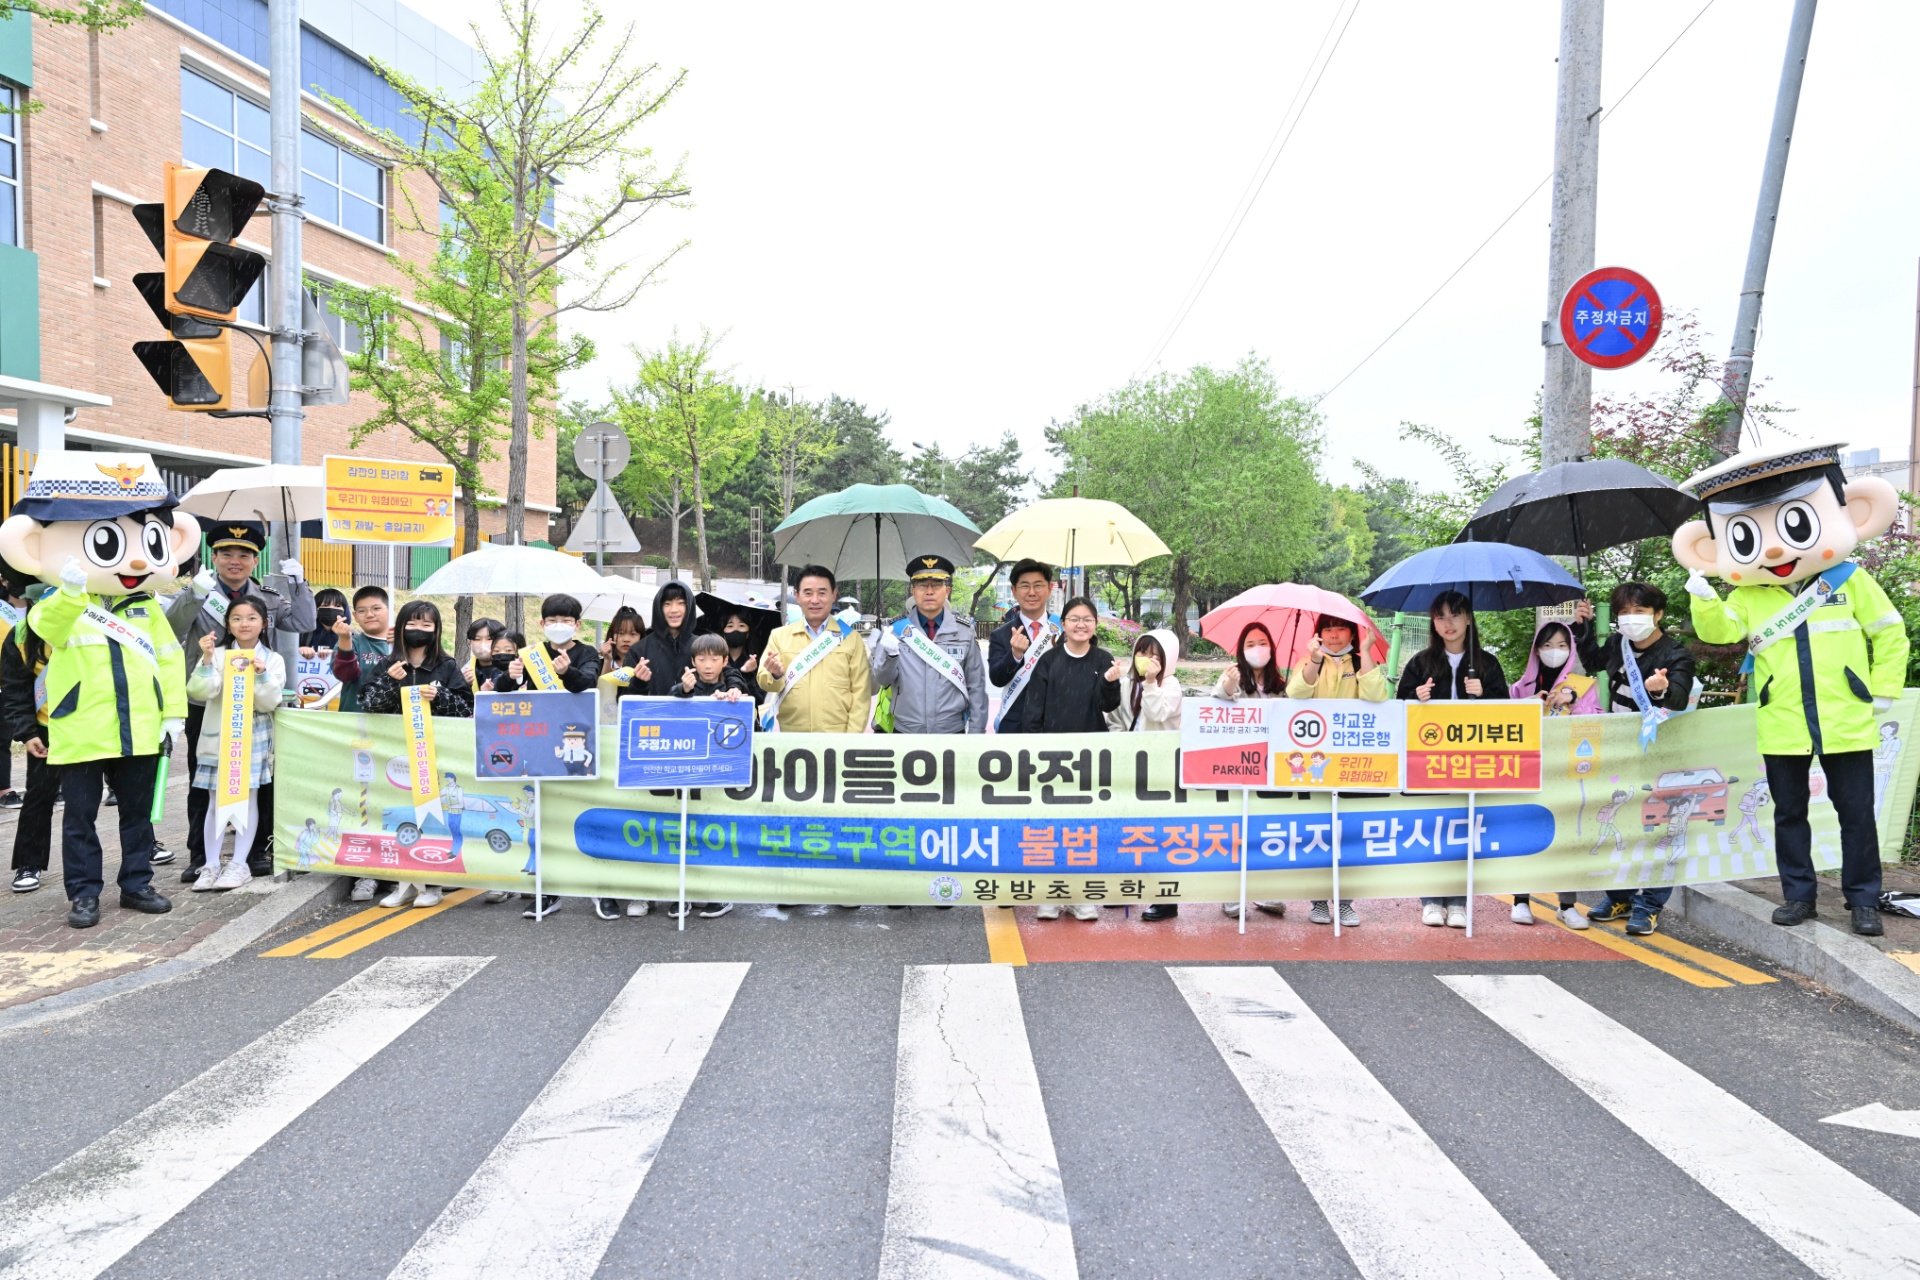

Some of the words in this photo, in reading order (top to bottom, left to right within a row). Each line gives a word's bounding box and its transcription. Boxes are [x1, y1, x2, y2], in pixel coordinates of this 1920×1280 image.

[1575, 310, 1647, 326] 주정차금지
[338, 493, 367, 505] 우리가
[371, 496, 413, 507] 위험해요!
[232, 675, 245, 701] 안전한
[491, 701, 516, 716] 학교
[518, 701, 533, 716] 앞
[1198, 706, 1262, 724] 주차금지
[231, 703, 244, 739] 우리학교
[411, 706, 425, 739] 우리학교
[1199, 725, 1220, 734] 등교길
[1238, 726, 1252, 734] 금지
[1293, 719, 1321, 738] 30
[1332, 713, 1376, 729] 학교앞
[1332, 731, 1391, 747] 안전운행
[1446, 723, 1524, 744] 여기부터
[638, 739, 671, 751] 주정차
[673, 739, 696, 751] NO!
[1240, 751, 1261, 765] NO
[1338, 756, 1373, 769] 우리가
[1425, 754, 1522, 779] 진입금지
[228, 760, 242, 795] 만들어요
[417, 760, 431, 795] 만들어요
[724, 747, 955, 805] 아이들의
[977, 748, 1112, 805] 안전!
[1212, 764, 1260, 776] PARKING
[1338, 770, 1388, 783] 위험해요!
[622, 818, 740, 858] 어린이
[757, 823, 999, 867] 보호구역에서
[1017, 825, 1098, 867] 불법
[1116, 822, 1243, 866] 주정차
[1260, 820, 1342, 861] 하지
[1361, 813, 1500, 858] 맙시다.
